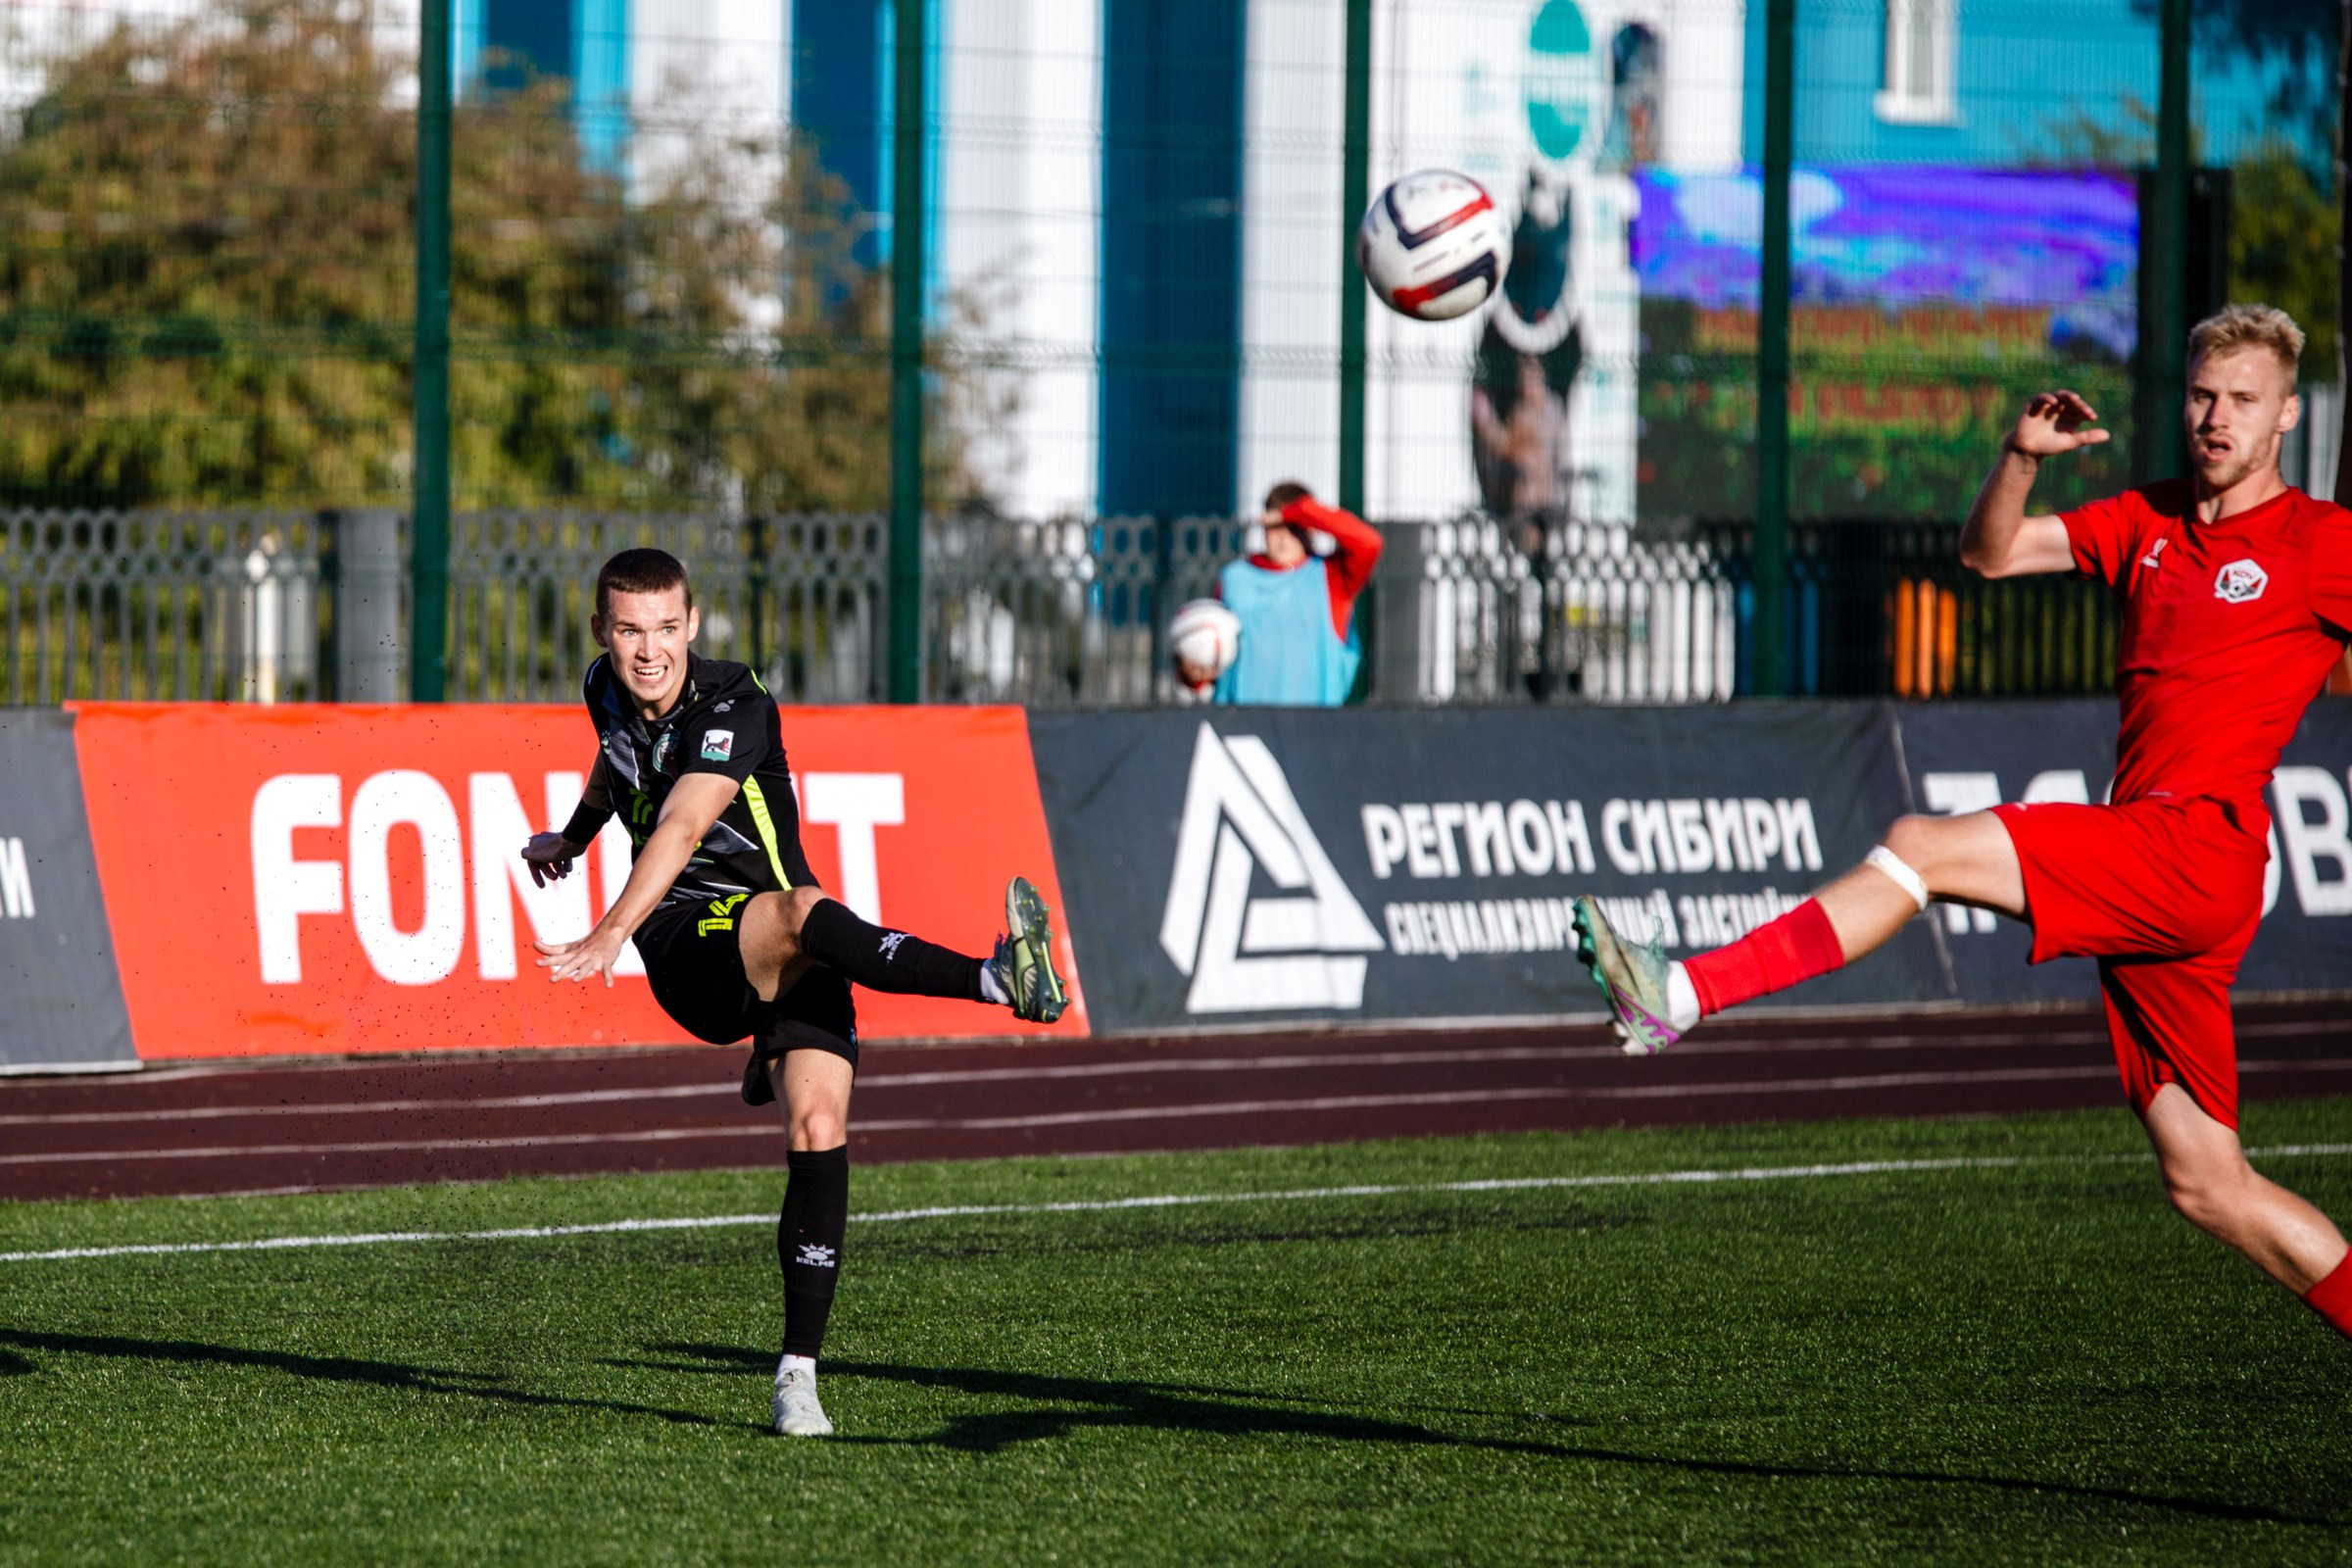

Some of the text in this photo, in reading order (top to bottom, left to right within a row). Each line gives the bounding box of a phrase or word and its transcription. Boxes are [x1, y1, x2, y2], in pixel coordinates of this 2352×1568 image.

[1360, 798, 1823, 878] РЕГИОН СИБИРИ
[251, 769, 905, 984] FONT
[698, 893, 749, 937] 14
[796, 1256, 835, 1268] KELME
